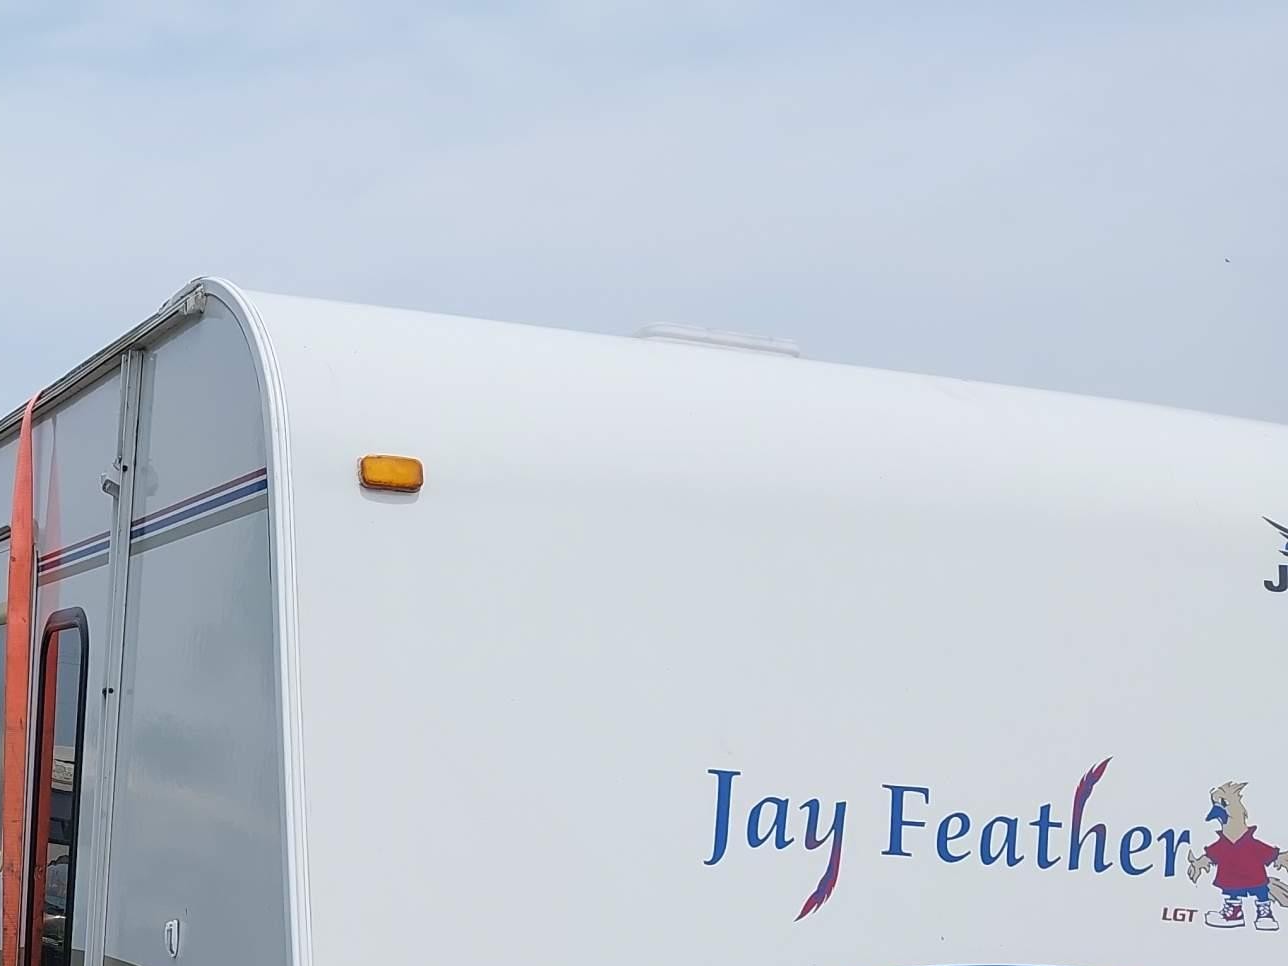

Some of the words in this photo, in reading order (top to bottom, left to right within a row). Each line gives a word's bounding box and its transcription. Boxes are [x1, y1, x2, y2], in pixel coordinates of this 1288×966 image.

[704, 769, 847, 922] Jay
[881, 756, 1191, 878] Feather
[1162, 907, 1198, 922] LGT
